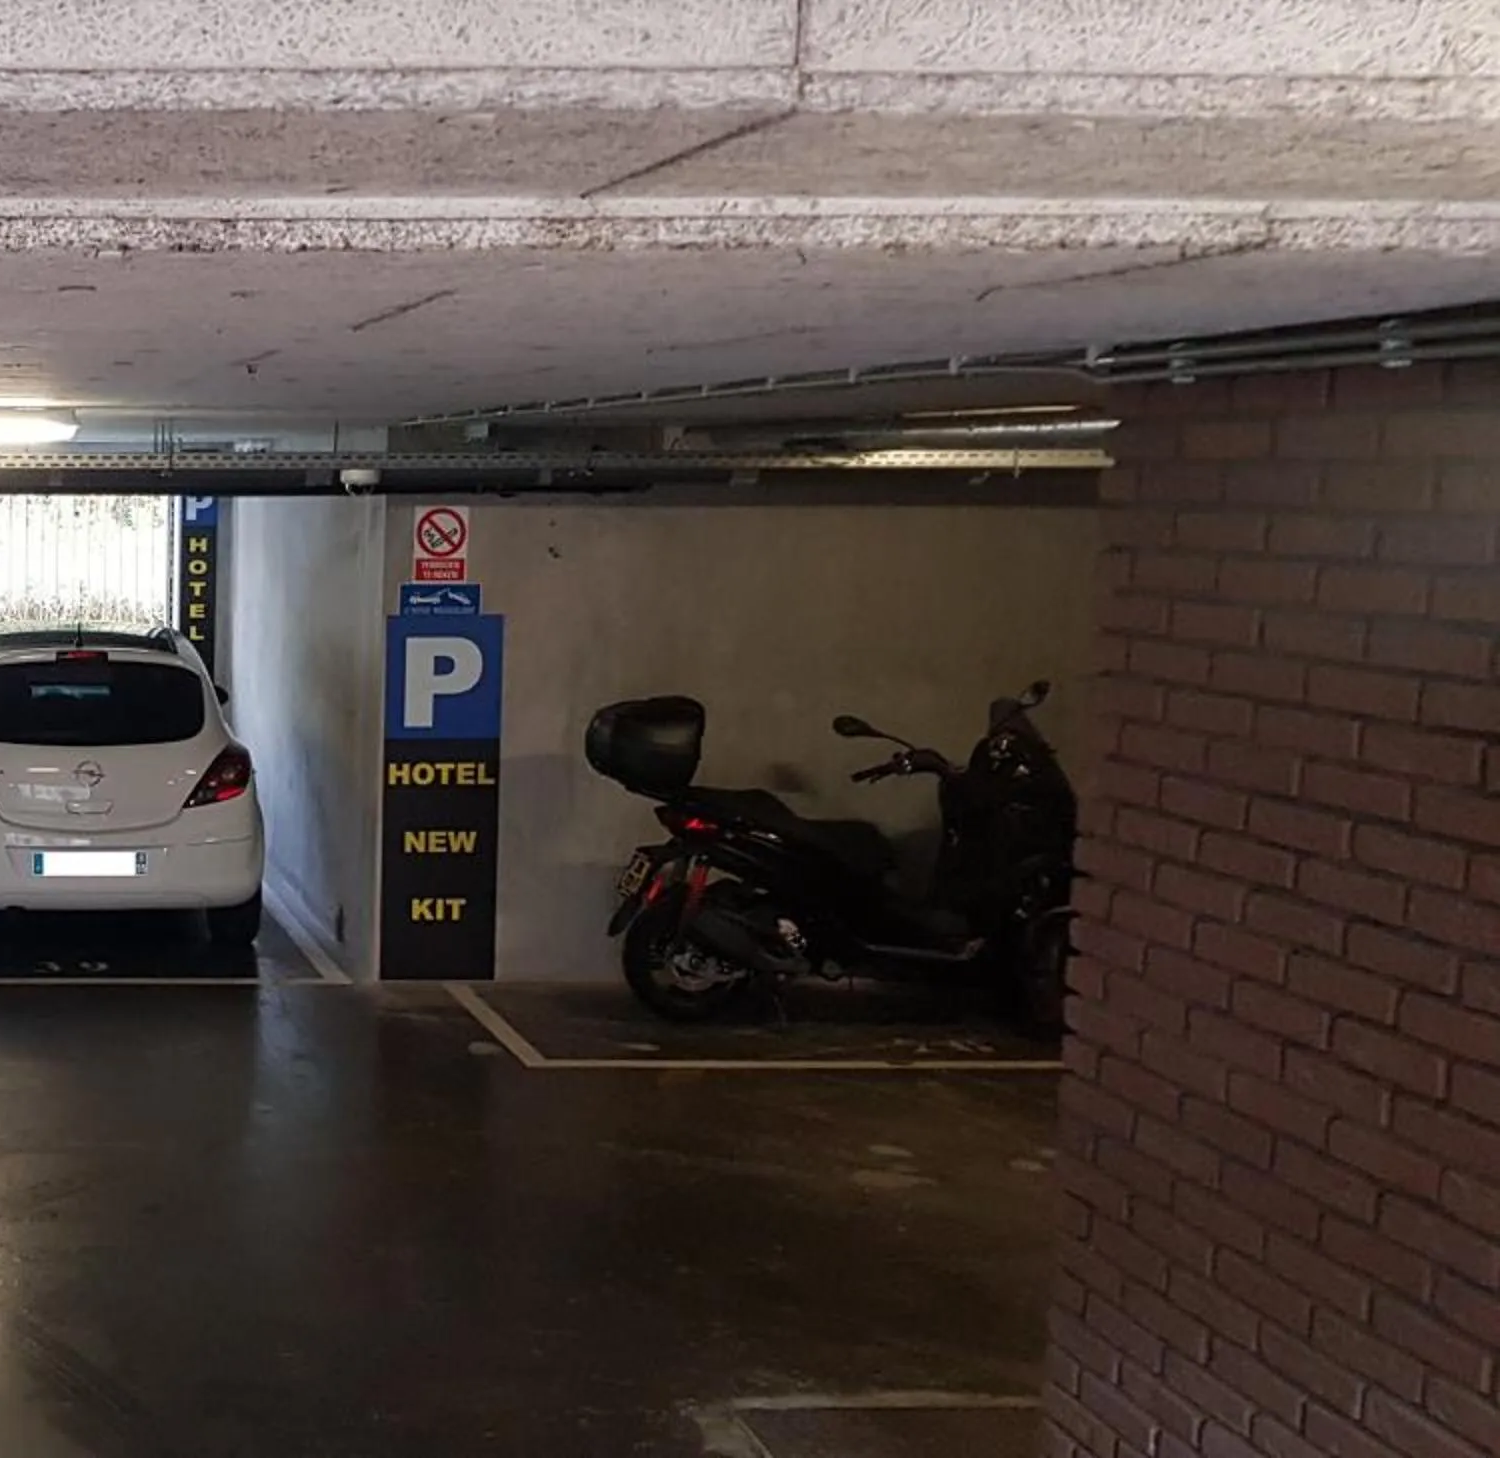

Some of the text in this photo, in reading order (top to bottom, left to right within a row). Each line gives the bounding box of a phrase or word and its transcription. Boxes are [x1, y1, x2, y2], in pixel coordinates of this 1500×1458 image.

[188, 537, 208, 641] HOTEL
[404, 637, 483, 727] P
[388, 763, 495, 785] HOTEL
[404, 832, 477, 853] NEW
[411, 898, 467, 921] KIT
